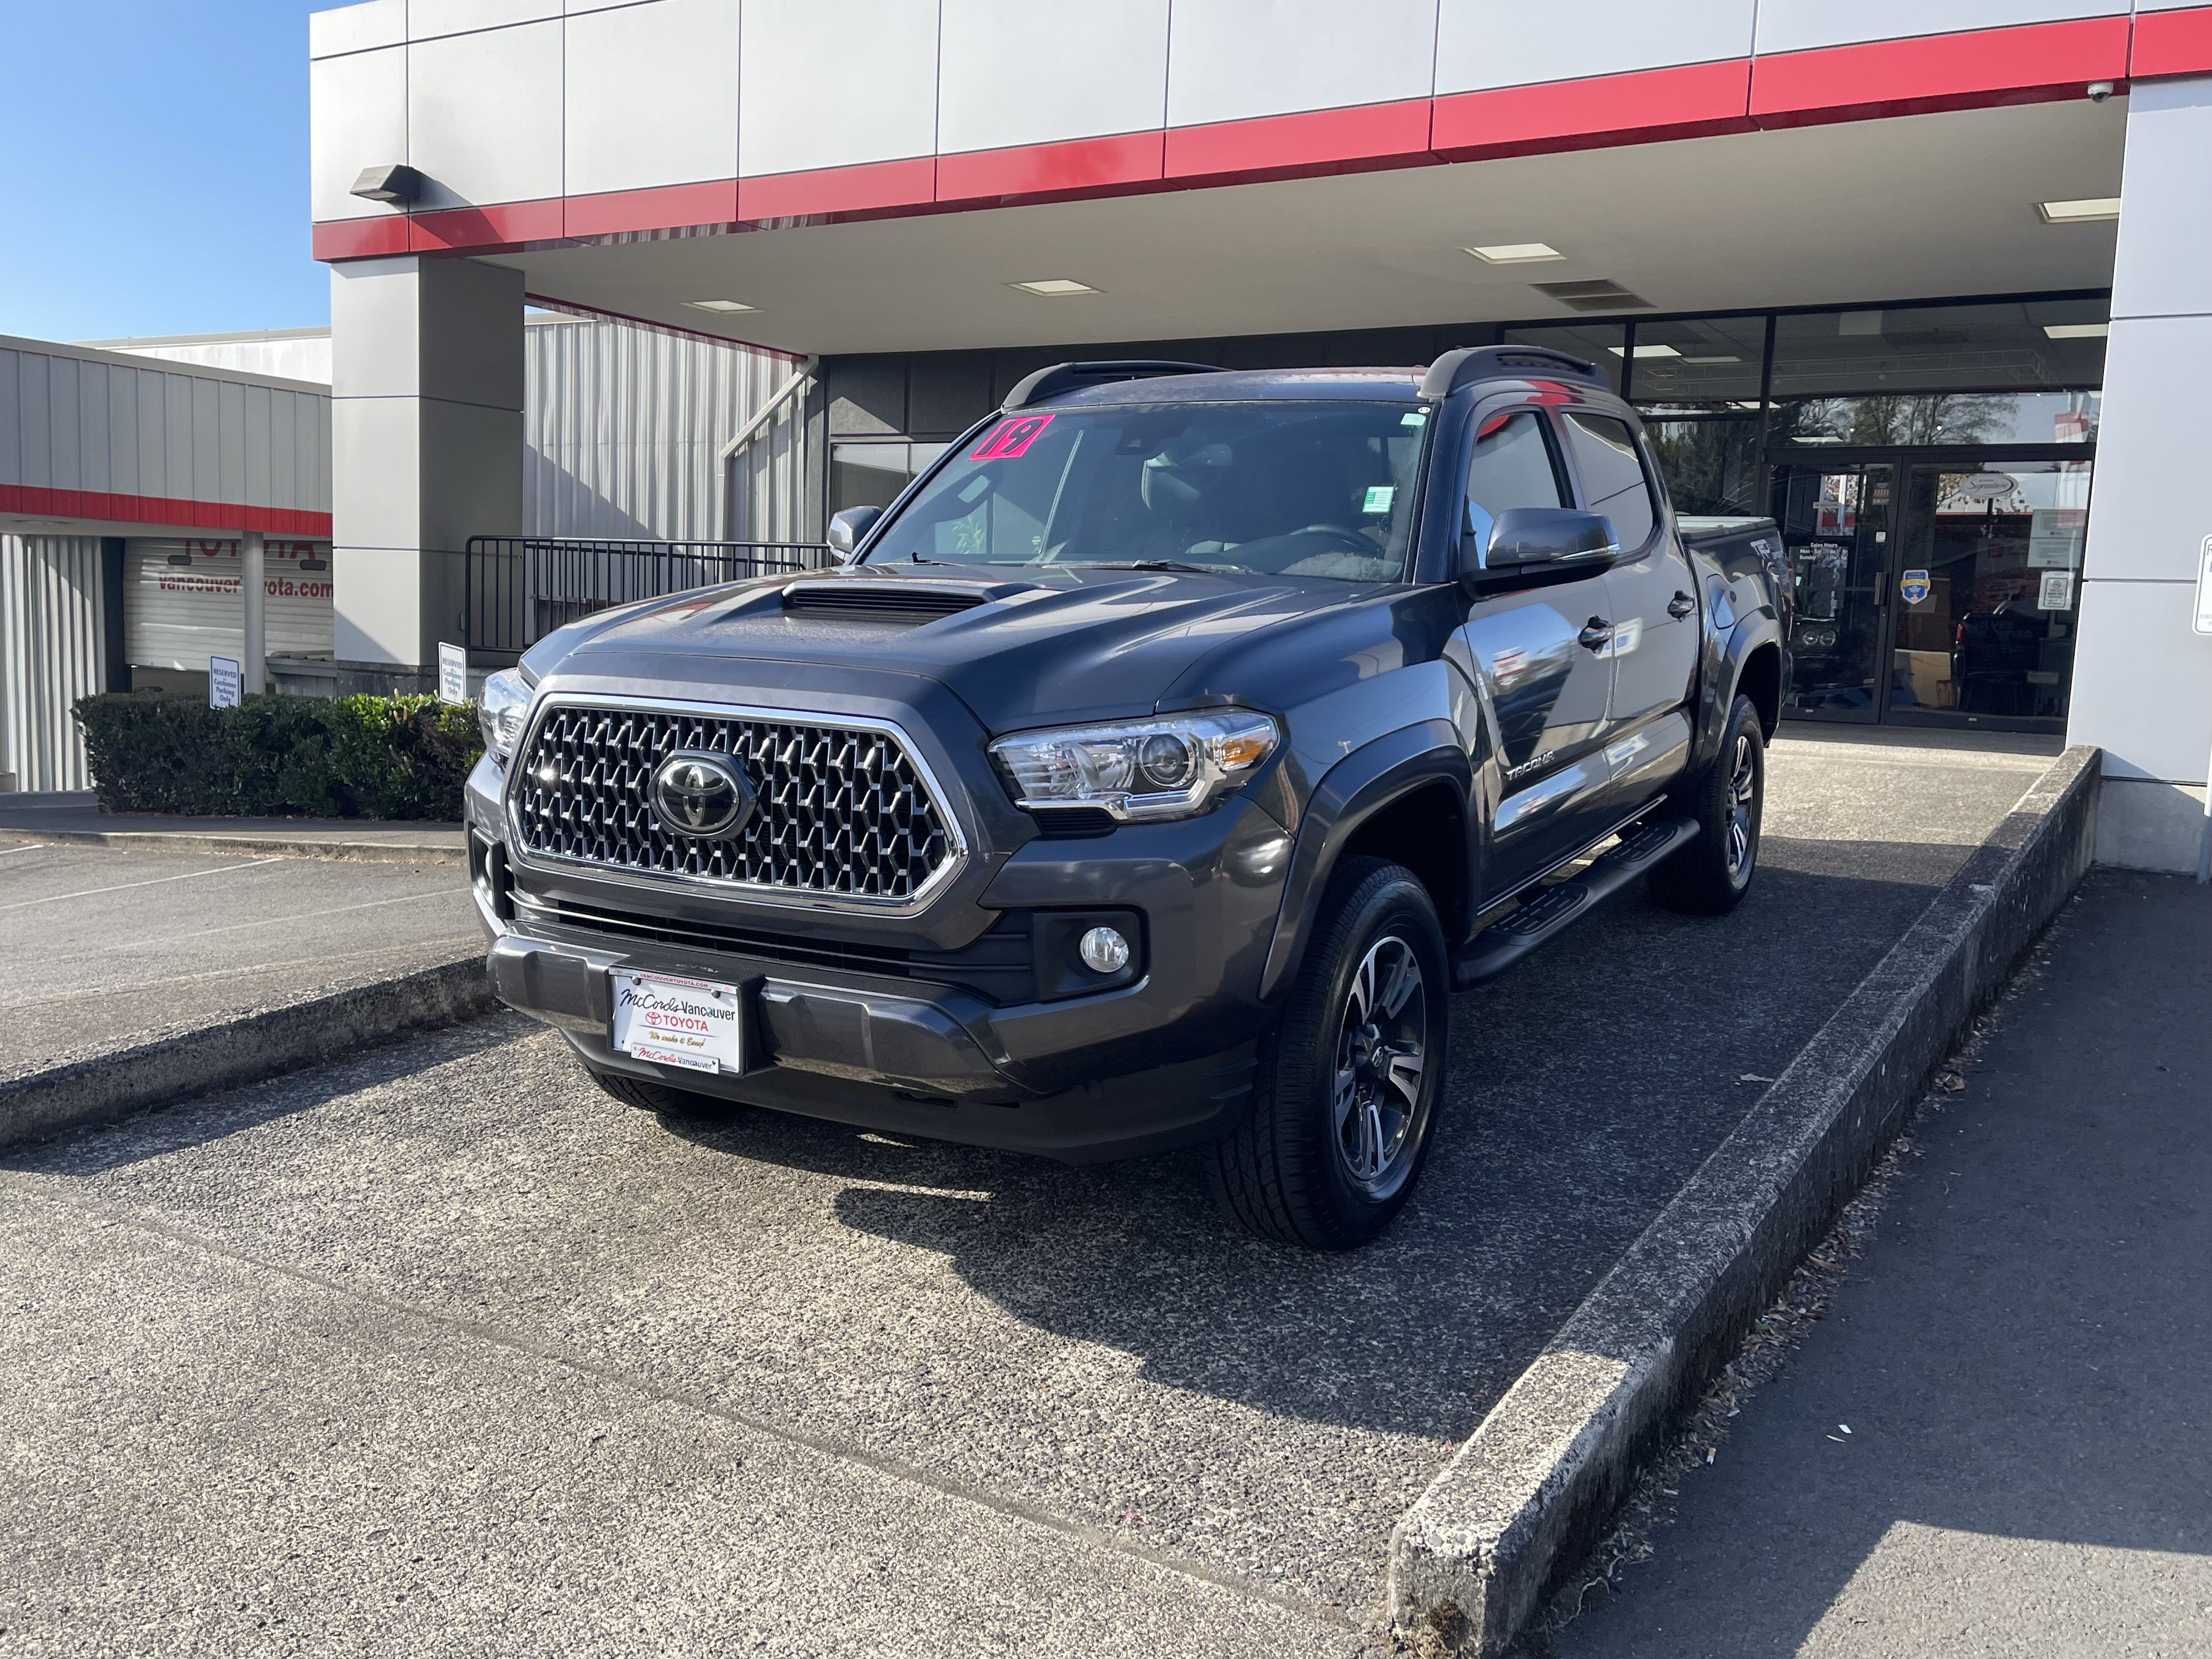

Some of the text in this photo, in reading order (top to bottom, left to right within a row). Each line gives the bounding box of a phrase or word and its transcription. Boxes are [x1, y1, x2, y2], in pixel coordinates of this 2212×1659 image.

[977, 419, 1043, 455] 19
[443, 657, 462, 669] RESERVED
[213, 668, 237, 678] RESERVED
[214, 678, 236, 689] Customer
[445, 677, 461, 690] Parking
[216, 686, 235, 697] Parking
[448, 686, 458, 697] Only
[219, 695, 231, 703] Only
[1506, 750, 1555, 781] TACOMA
[639, 973, 708, 988] VANCOUVERTOYOTA.COM
[664, 1015, 708, 1031] TOYOTA
[649, 1030, 660, 1040] We
